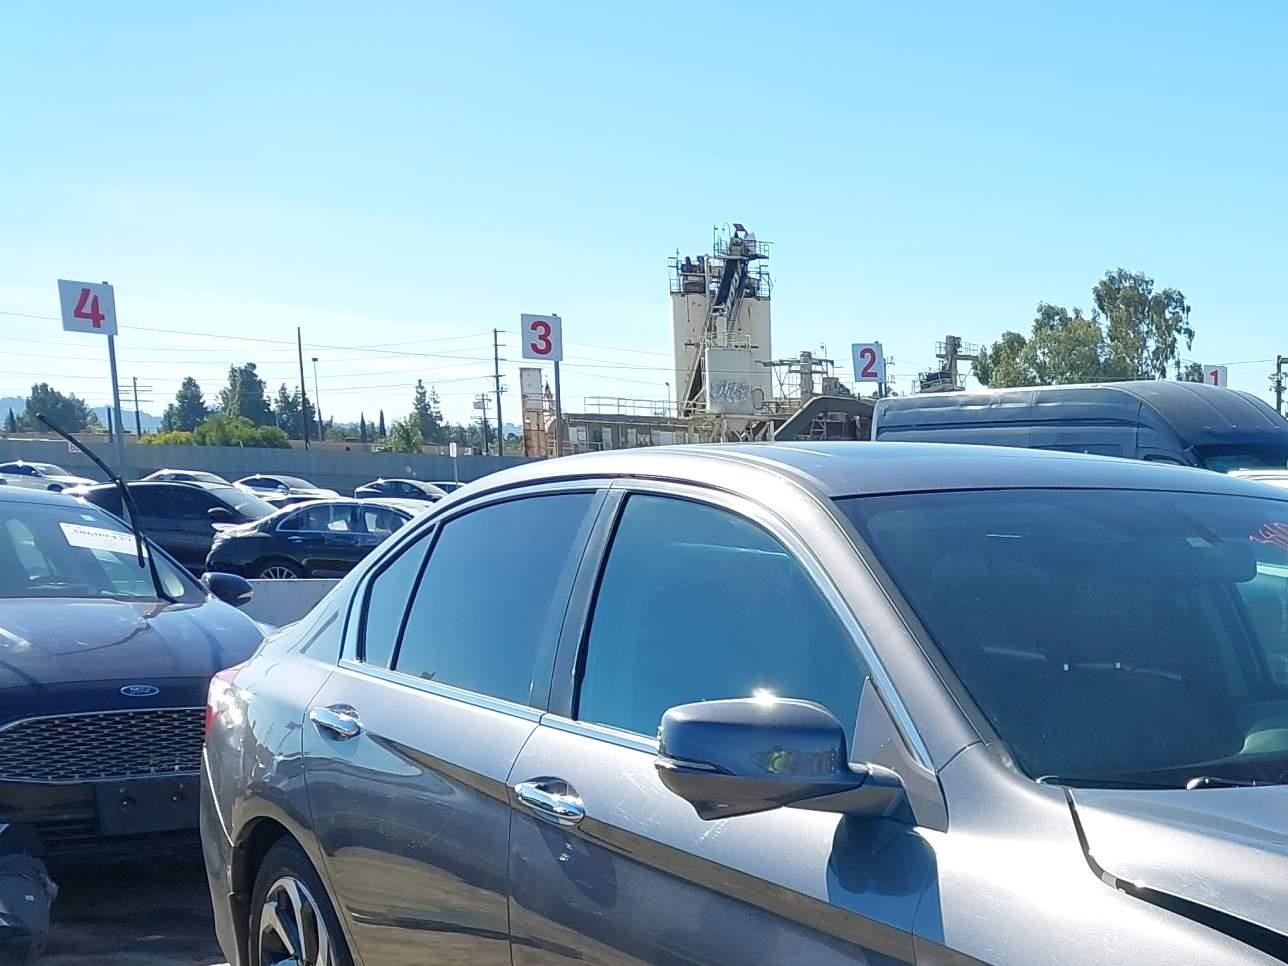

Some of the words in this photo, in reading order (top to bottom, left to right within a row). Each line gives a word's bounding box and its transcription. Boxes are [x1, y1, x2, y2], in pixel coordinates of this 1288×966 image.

[73, 287, 105, 329] 4
[530, 320, 553, 355] 3
[859, 347, 878, 378] 2
[1210, 369, 1219, 386] 1
